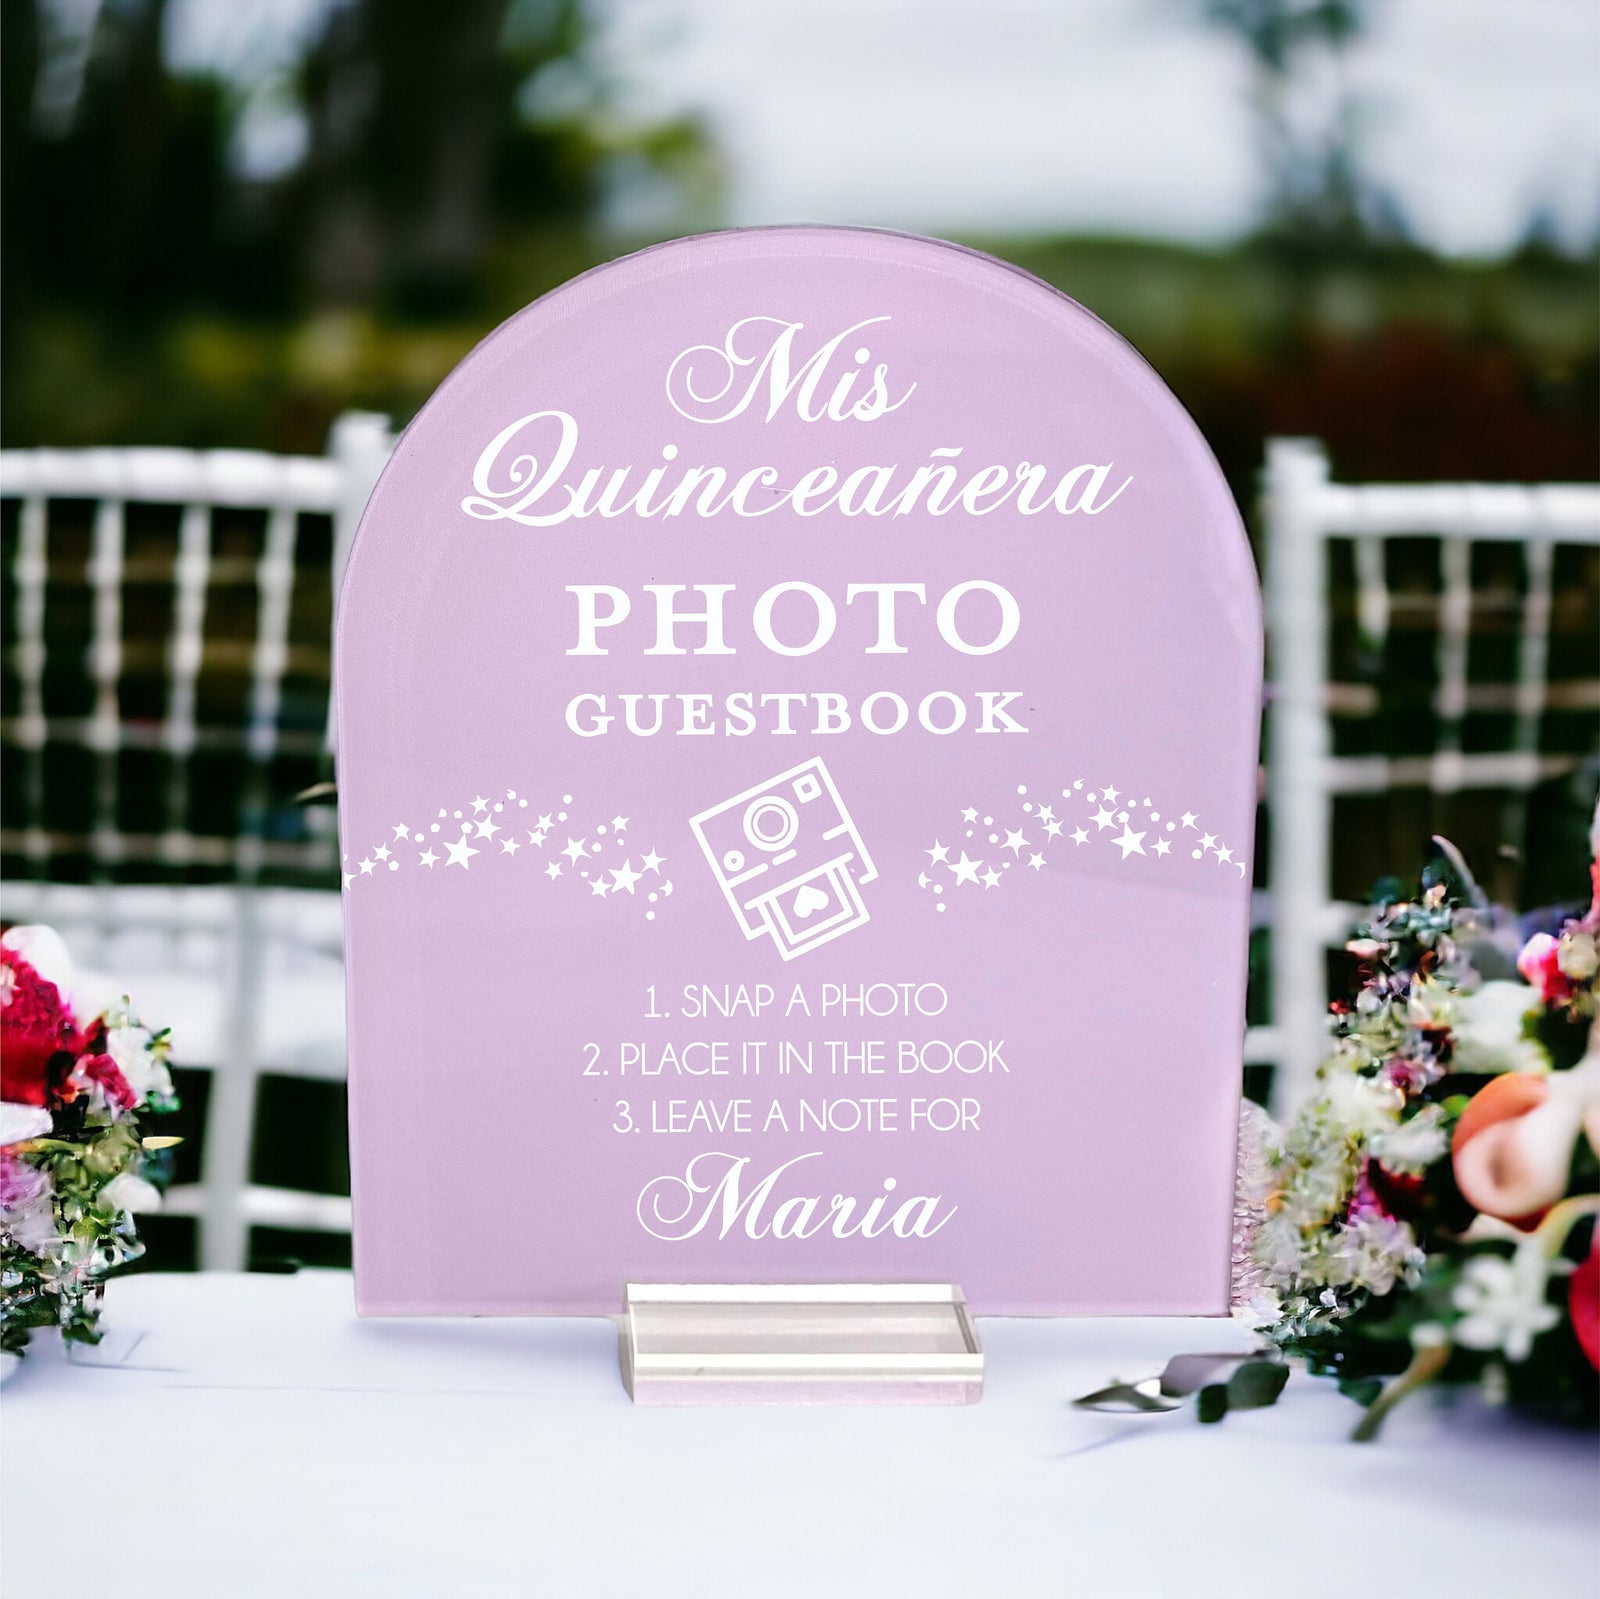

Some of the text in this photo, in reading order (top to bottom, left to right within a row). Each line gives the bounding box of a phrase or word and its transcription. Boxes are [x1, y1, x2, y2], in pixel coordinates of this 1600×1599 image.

[666, 316, 917, 423] Mis
[461, 410, 1133, 526] Quinceañera
[565, 580, 1020, 656] PHOTO
[566, 691, 1028, 737] GUESTBOOK
[645, 983, 948, 1018] 1. SNAP A PHOTO
[583, 1040, 1010, 1076] 2. PLACE IT IN THE BOOK
[613, 1098, 981, 1134] 3. LEAVE A NOTE FOR
[637, 1152, 958, 1240] Maria
